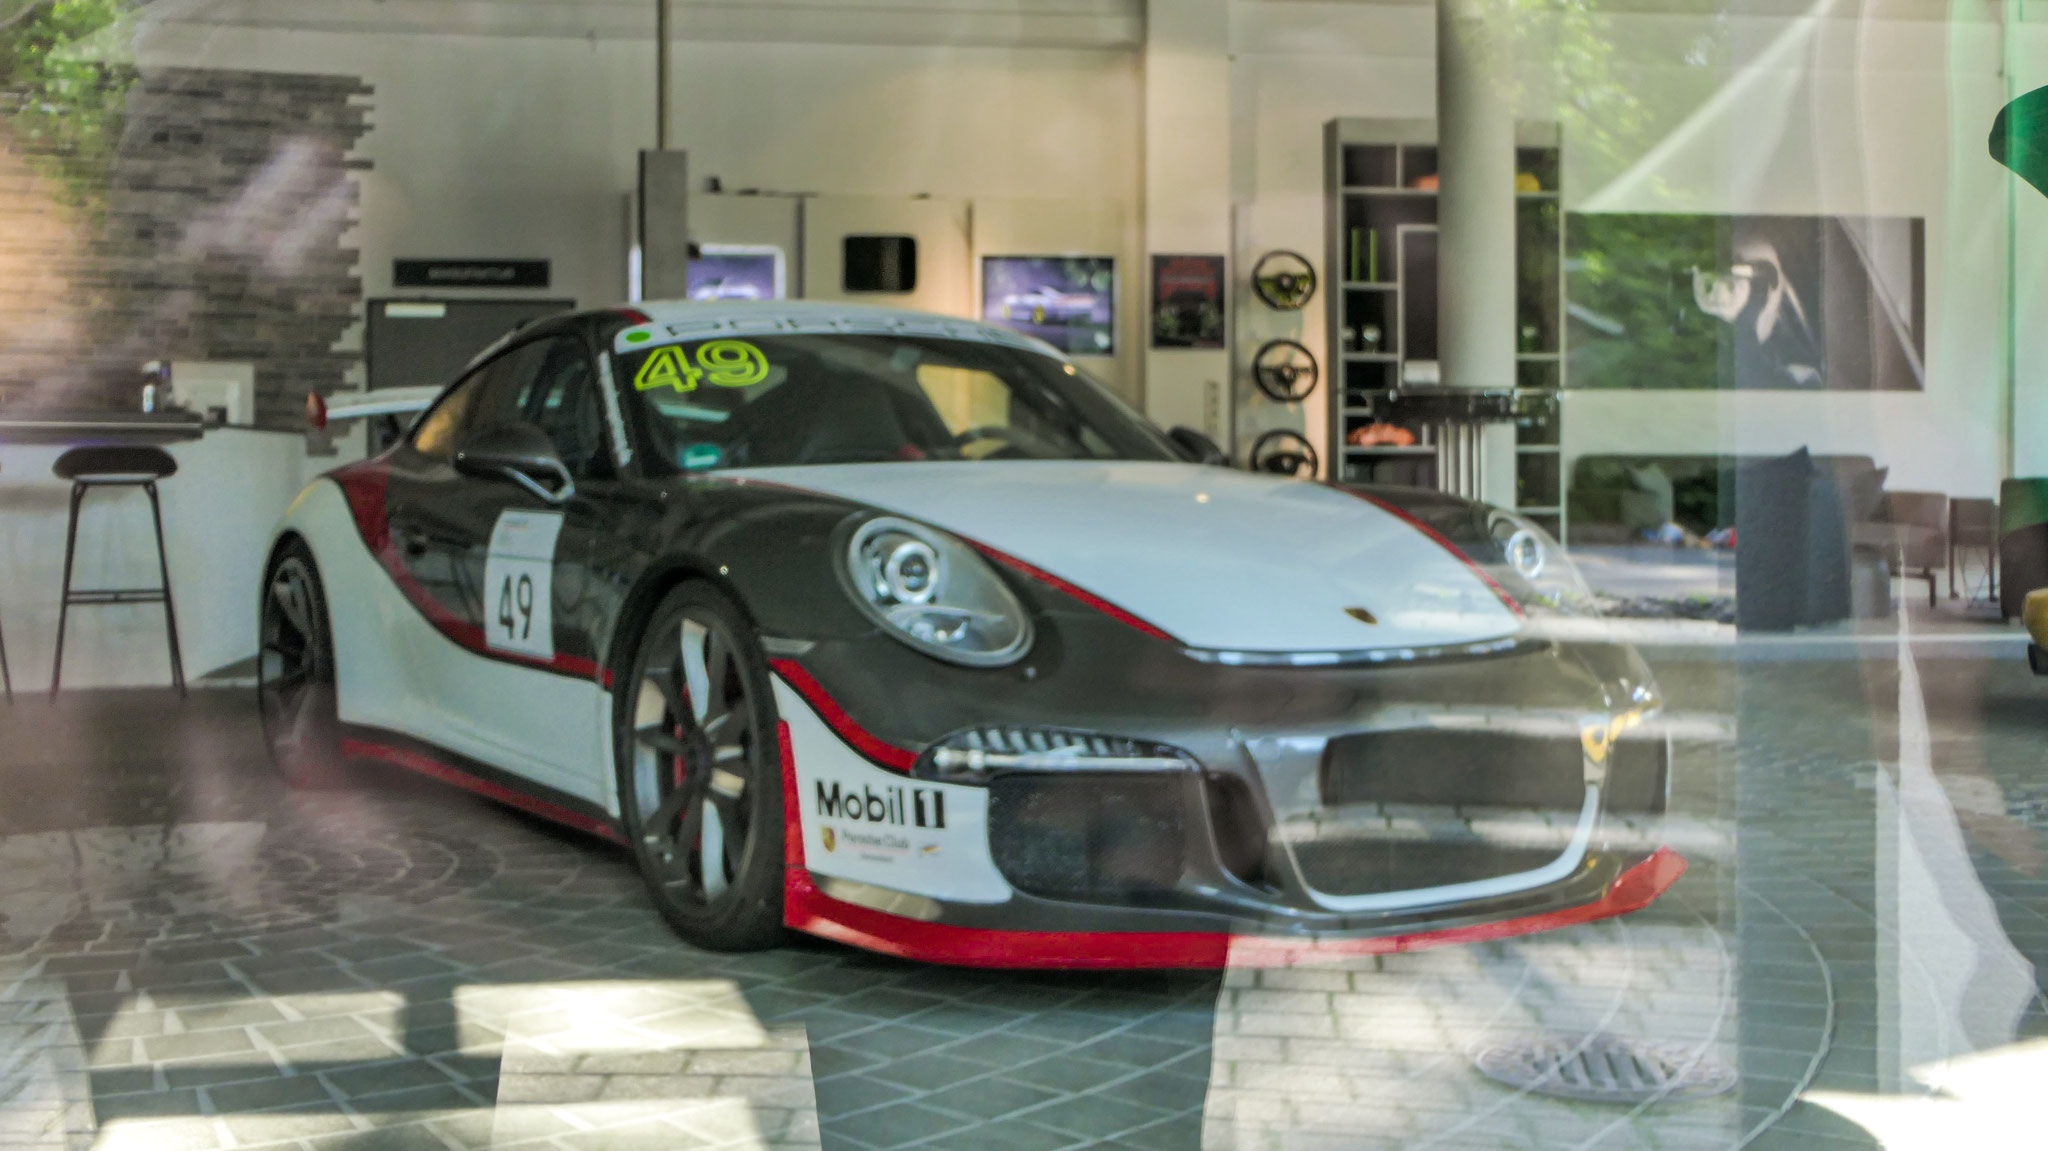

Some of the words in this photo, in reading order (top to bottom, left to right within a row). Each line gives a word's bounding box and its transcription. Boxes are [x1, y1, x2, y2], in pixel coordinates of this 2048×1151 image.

[634, 340, 769, 393] 49
[499, 573, 532, 640] 49
[816, 779, 905, 825] Mobil
[914, 789, 945, 829] 1
